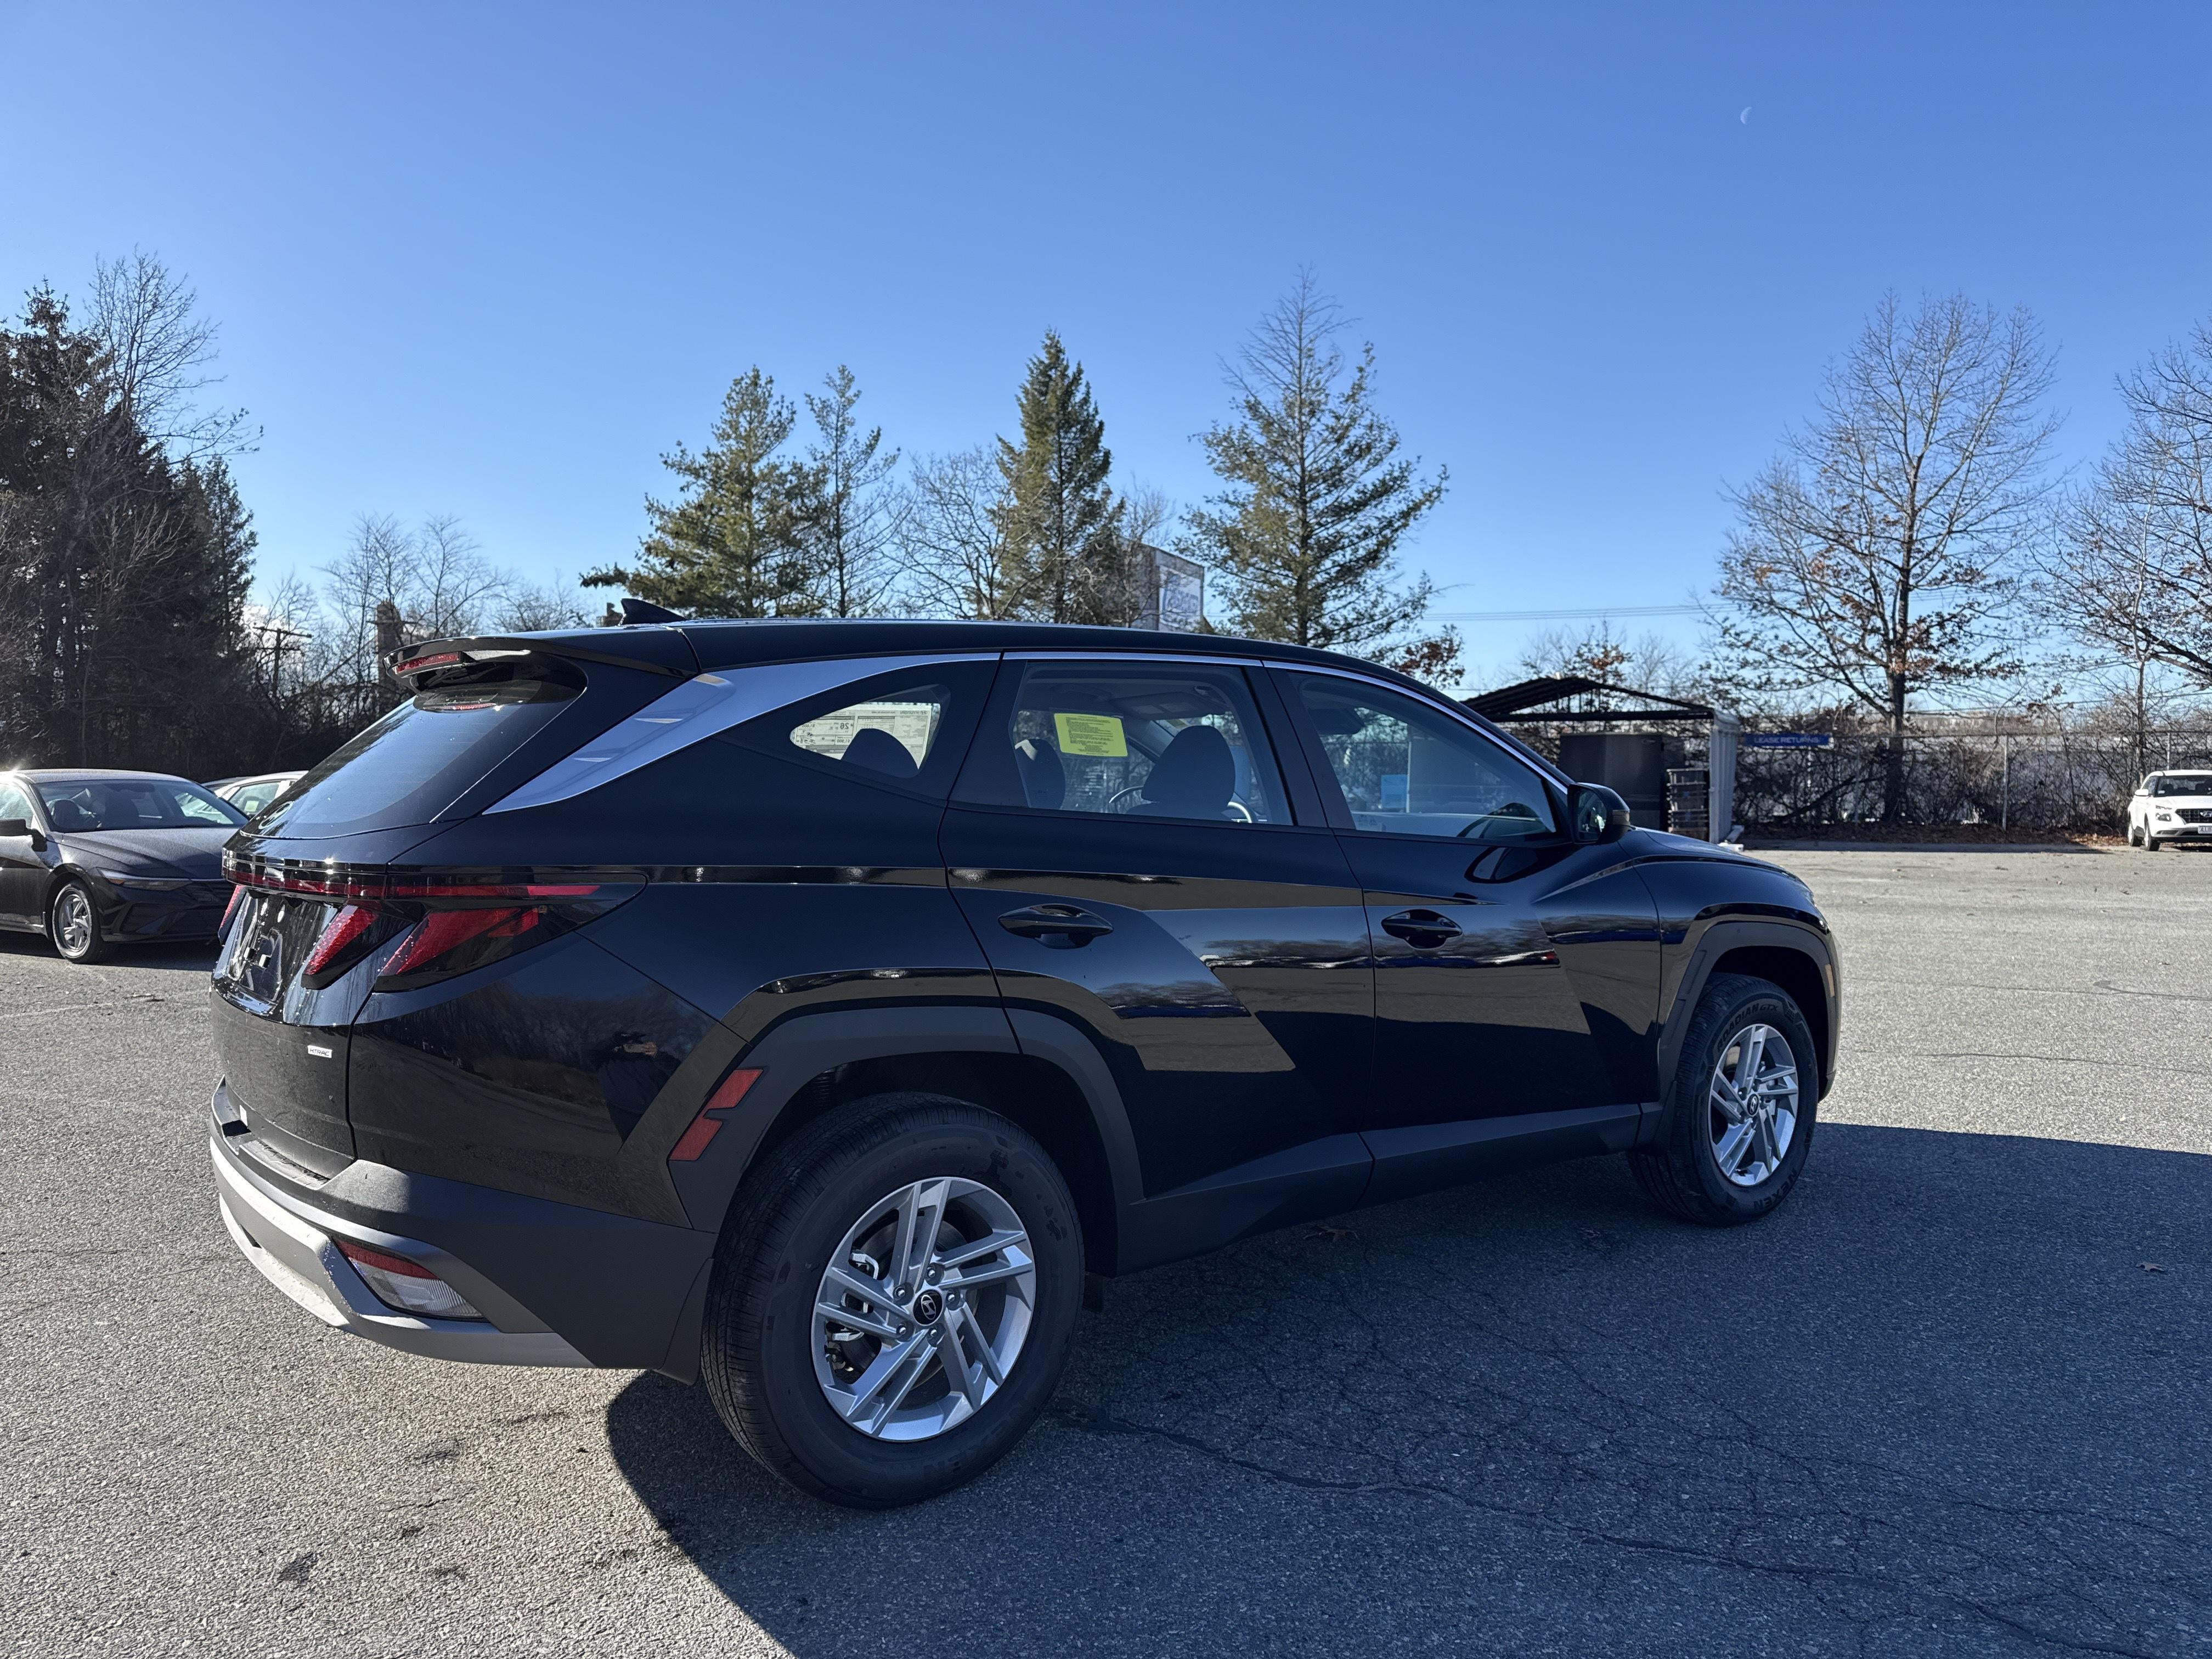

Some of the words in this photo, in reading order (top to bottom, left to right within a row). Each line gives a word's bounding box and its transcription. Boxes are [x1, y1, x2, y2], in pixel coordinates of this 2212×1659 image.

[1717, 1003, 1760, 1052] ROADIAN
[309, 1048, 330, 1057] HTRAC
[1753, 1167, 1797, 1212] NEXEN
